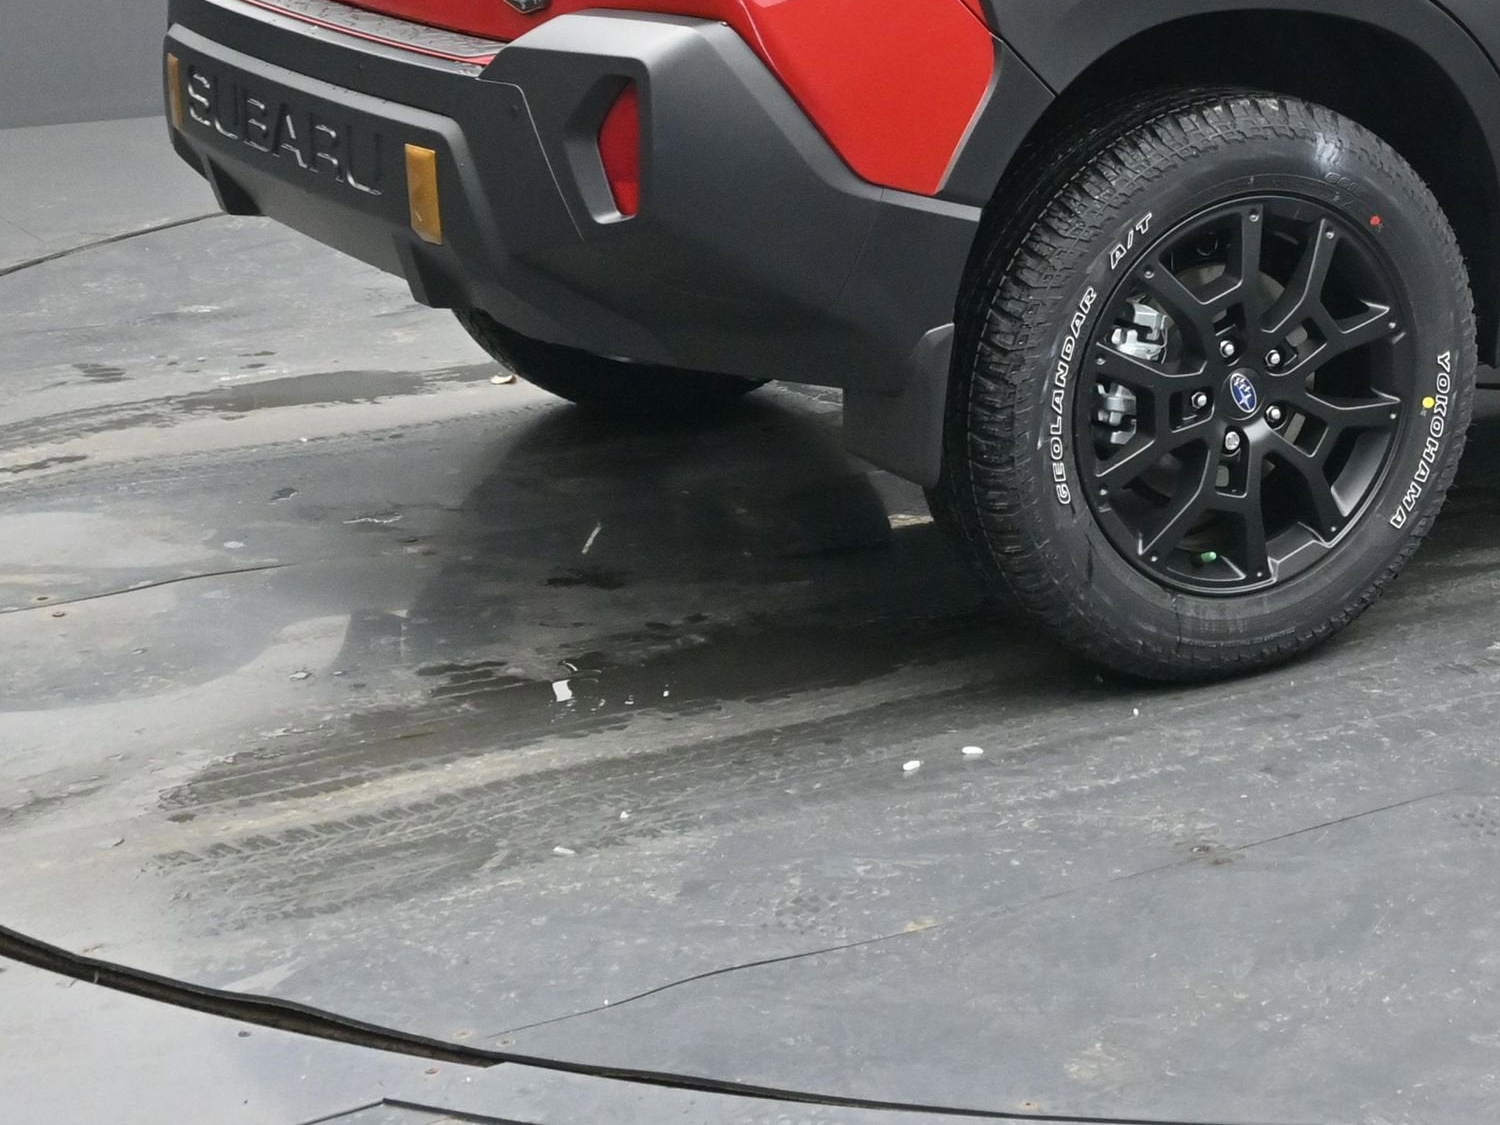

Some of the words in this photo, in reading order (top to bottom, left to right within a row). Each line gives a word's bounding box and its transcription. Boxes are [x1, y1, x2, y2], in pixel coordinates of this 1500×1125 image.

[187, 65, 383, 196] SUBARU
[1050, 286, 1097, 504] GEOLANDAR
[1111, 212, 1152, 269] A/T
[1390, 351, 1451, 529] YOKOHAMA
